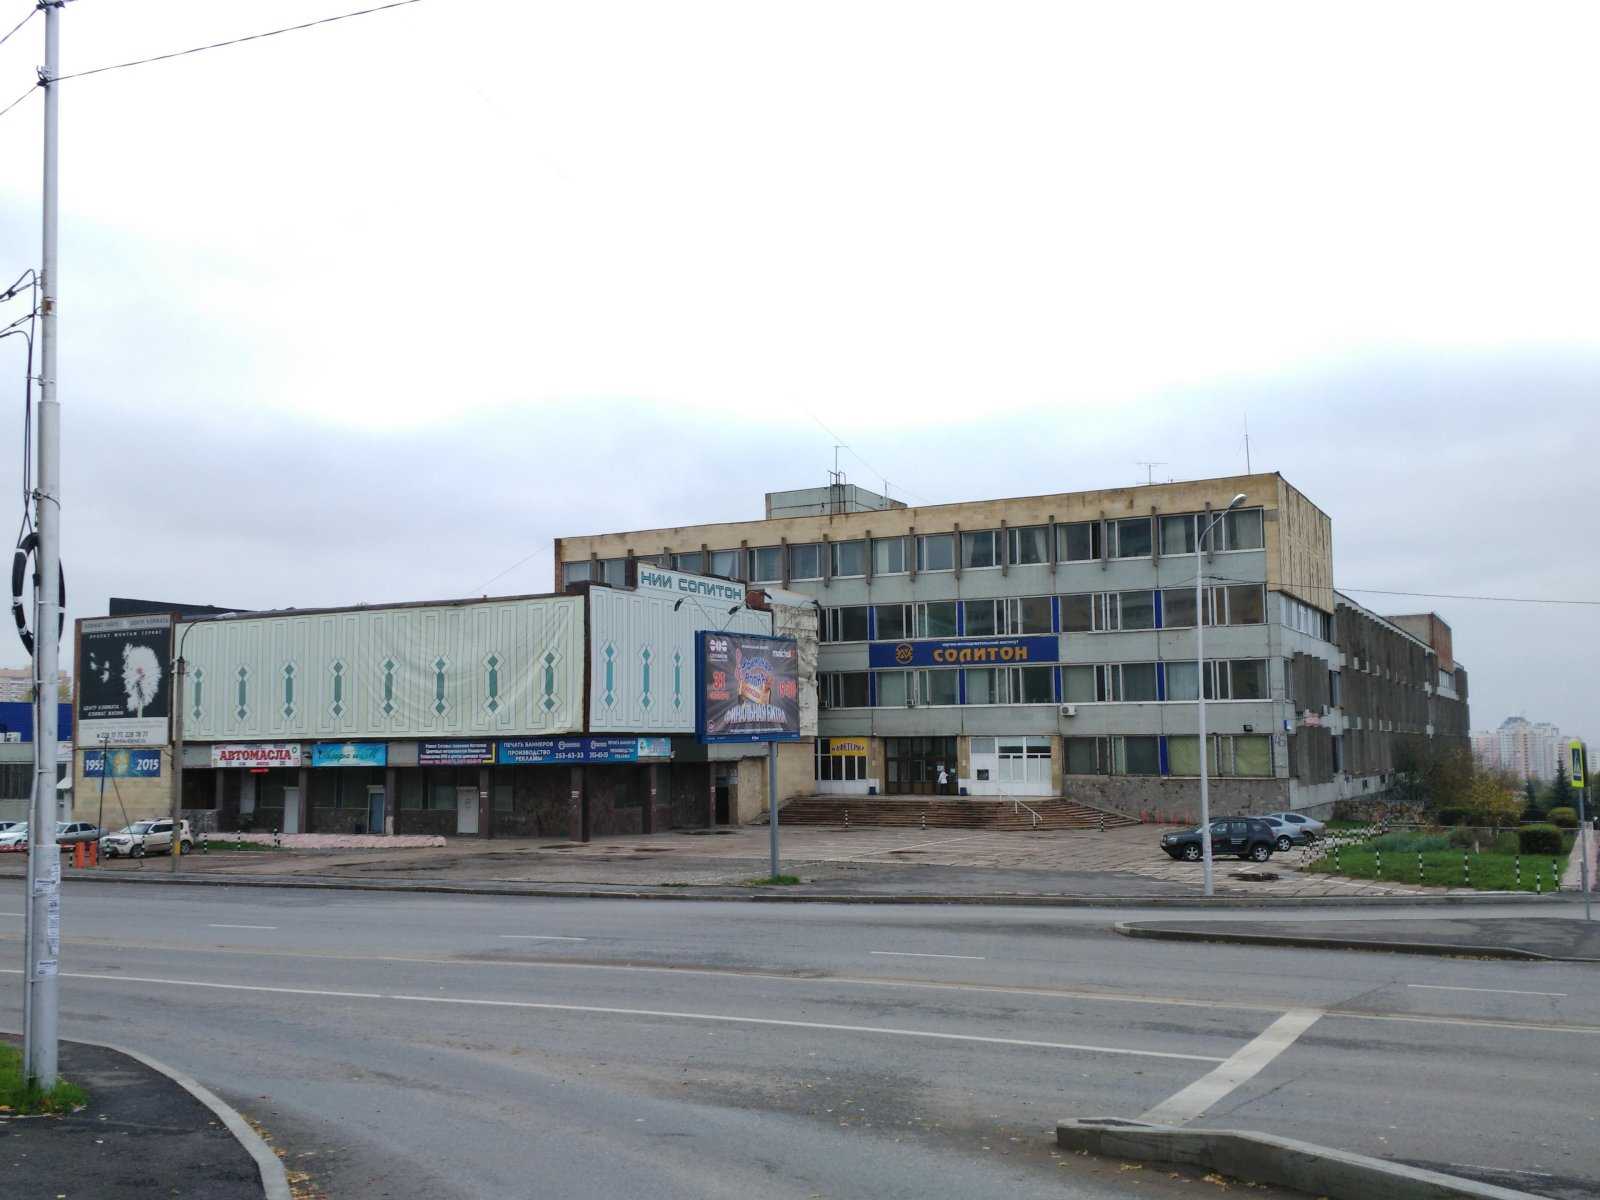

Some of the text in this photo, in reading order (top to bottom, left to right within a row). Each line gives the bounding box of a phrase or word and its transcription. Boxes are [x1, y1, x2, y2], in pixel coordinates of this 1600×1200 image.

[640, 570, 673, 589] НИИ
[932, 646, 1029, 663] СОЛИТОН
[219, 749, 292, 761] АВТОМАСЛА
[136, 758, 160, 771] 2015
